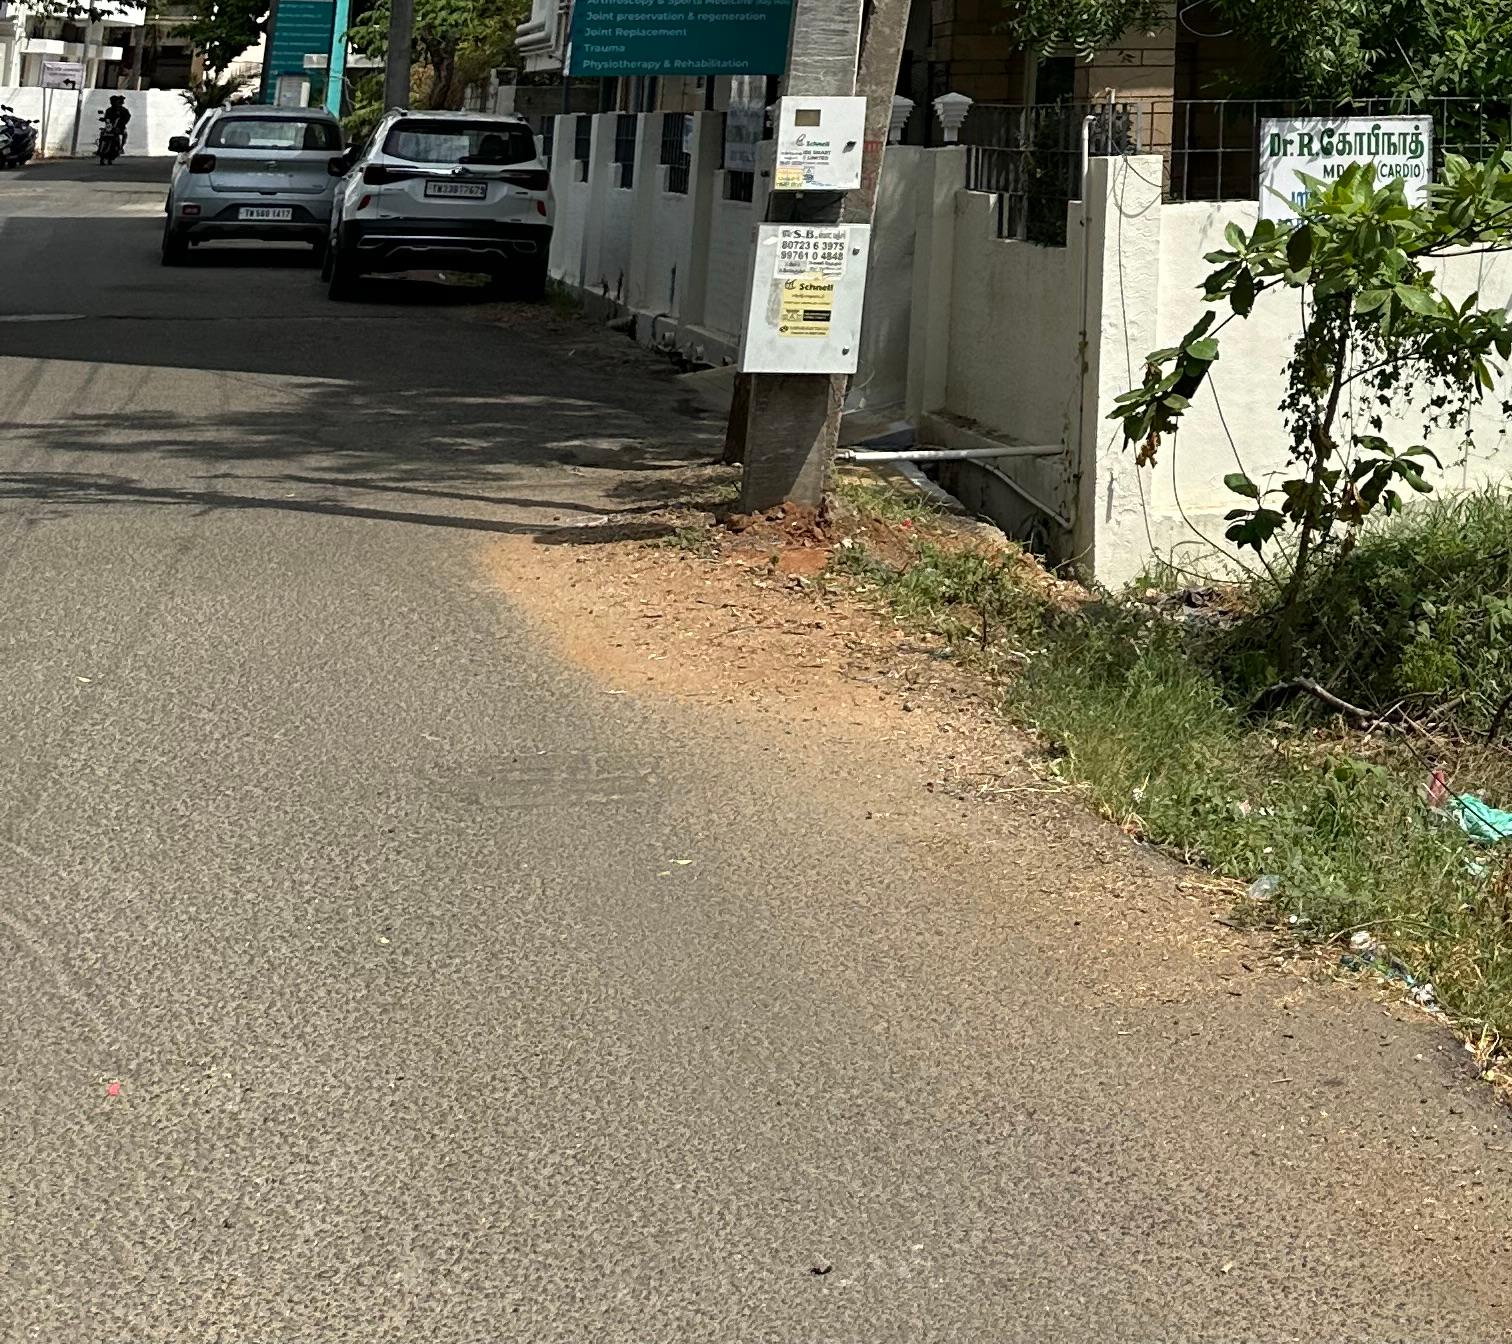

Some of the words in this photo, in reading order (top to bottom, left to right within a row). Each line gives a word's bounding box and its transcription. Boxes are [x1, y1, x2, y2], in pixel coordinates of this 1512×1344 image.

[586, 12, 613, 20] Joint
[616, 12, 684, 22] preservation
[697, 13, 767, 22] regeneration
[584, 27, 612, 36] Joint
[615, 27, 687, 38] Replacement
[583, 44, 626, 52] Trauma
[583, 60, 661, 70] Physiotherapy
[674, 58, 749, 68] Rehabilitation
[1269, 132, 1294, 157] Dr.
[1297, 132, 1319, 157] R.
[1320, 123, 1425, 162] கோபிநாத்
[1377, 161, 1425, 183] (CARDIO)
[799, 283, 834, 291] Schnell
